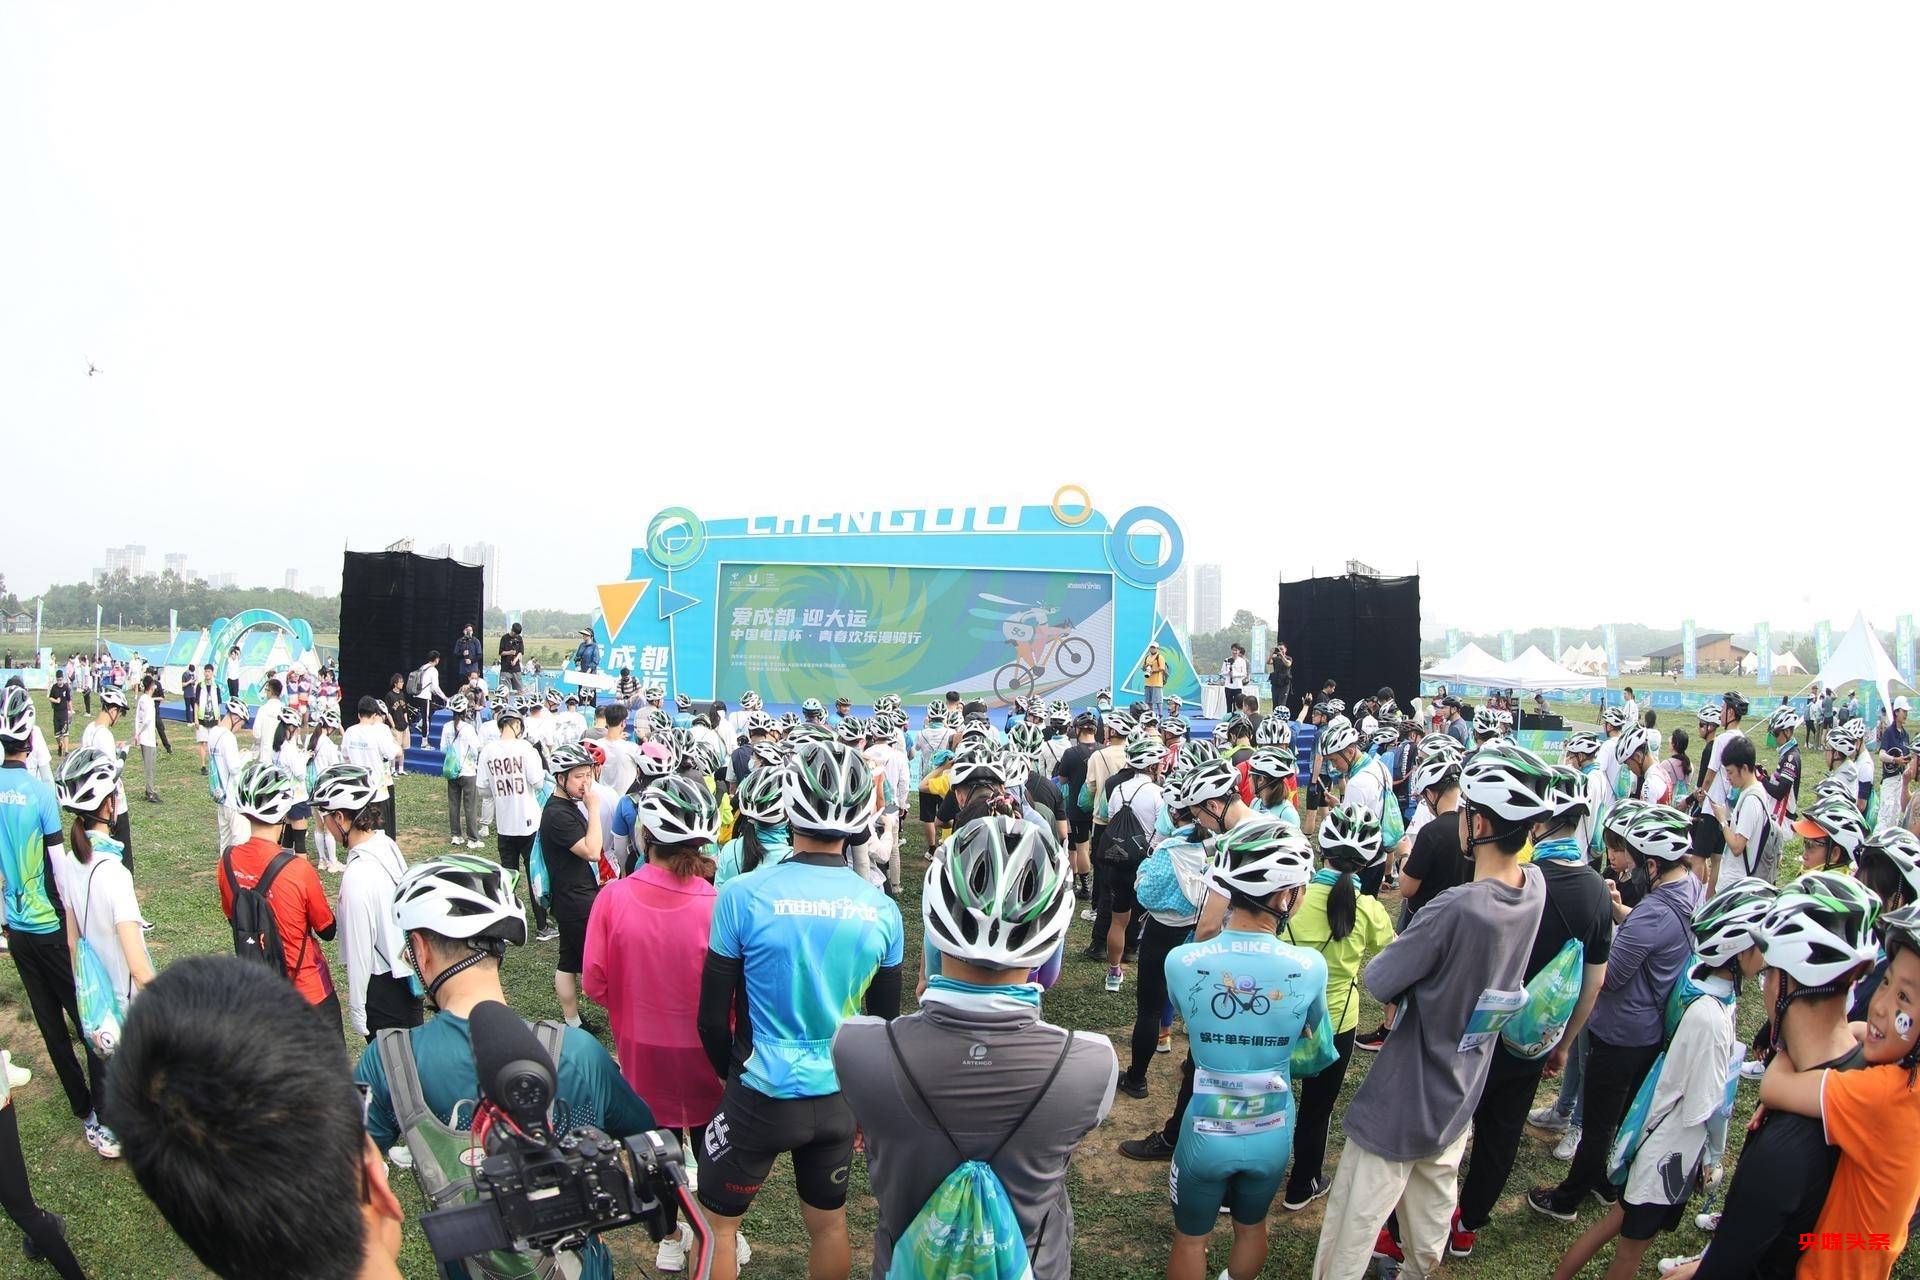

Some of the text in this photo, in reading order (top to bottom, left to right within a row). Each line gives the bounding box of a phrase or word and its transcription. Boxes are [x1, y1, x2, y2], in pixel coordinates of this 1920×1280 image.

[732, 607, 868, 628] 爱成都 迎大运
[1011, 626, 1026, 638] 5G
[494, 777, 525, 797] AND
[1181, 940, 1313, 970] SNAIL BIKE CLUB
[1199, 1032, 1290, 1047] 蜗牛单车俱乐部
[1217, 1098, 1266, 1117] 172
